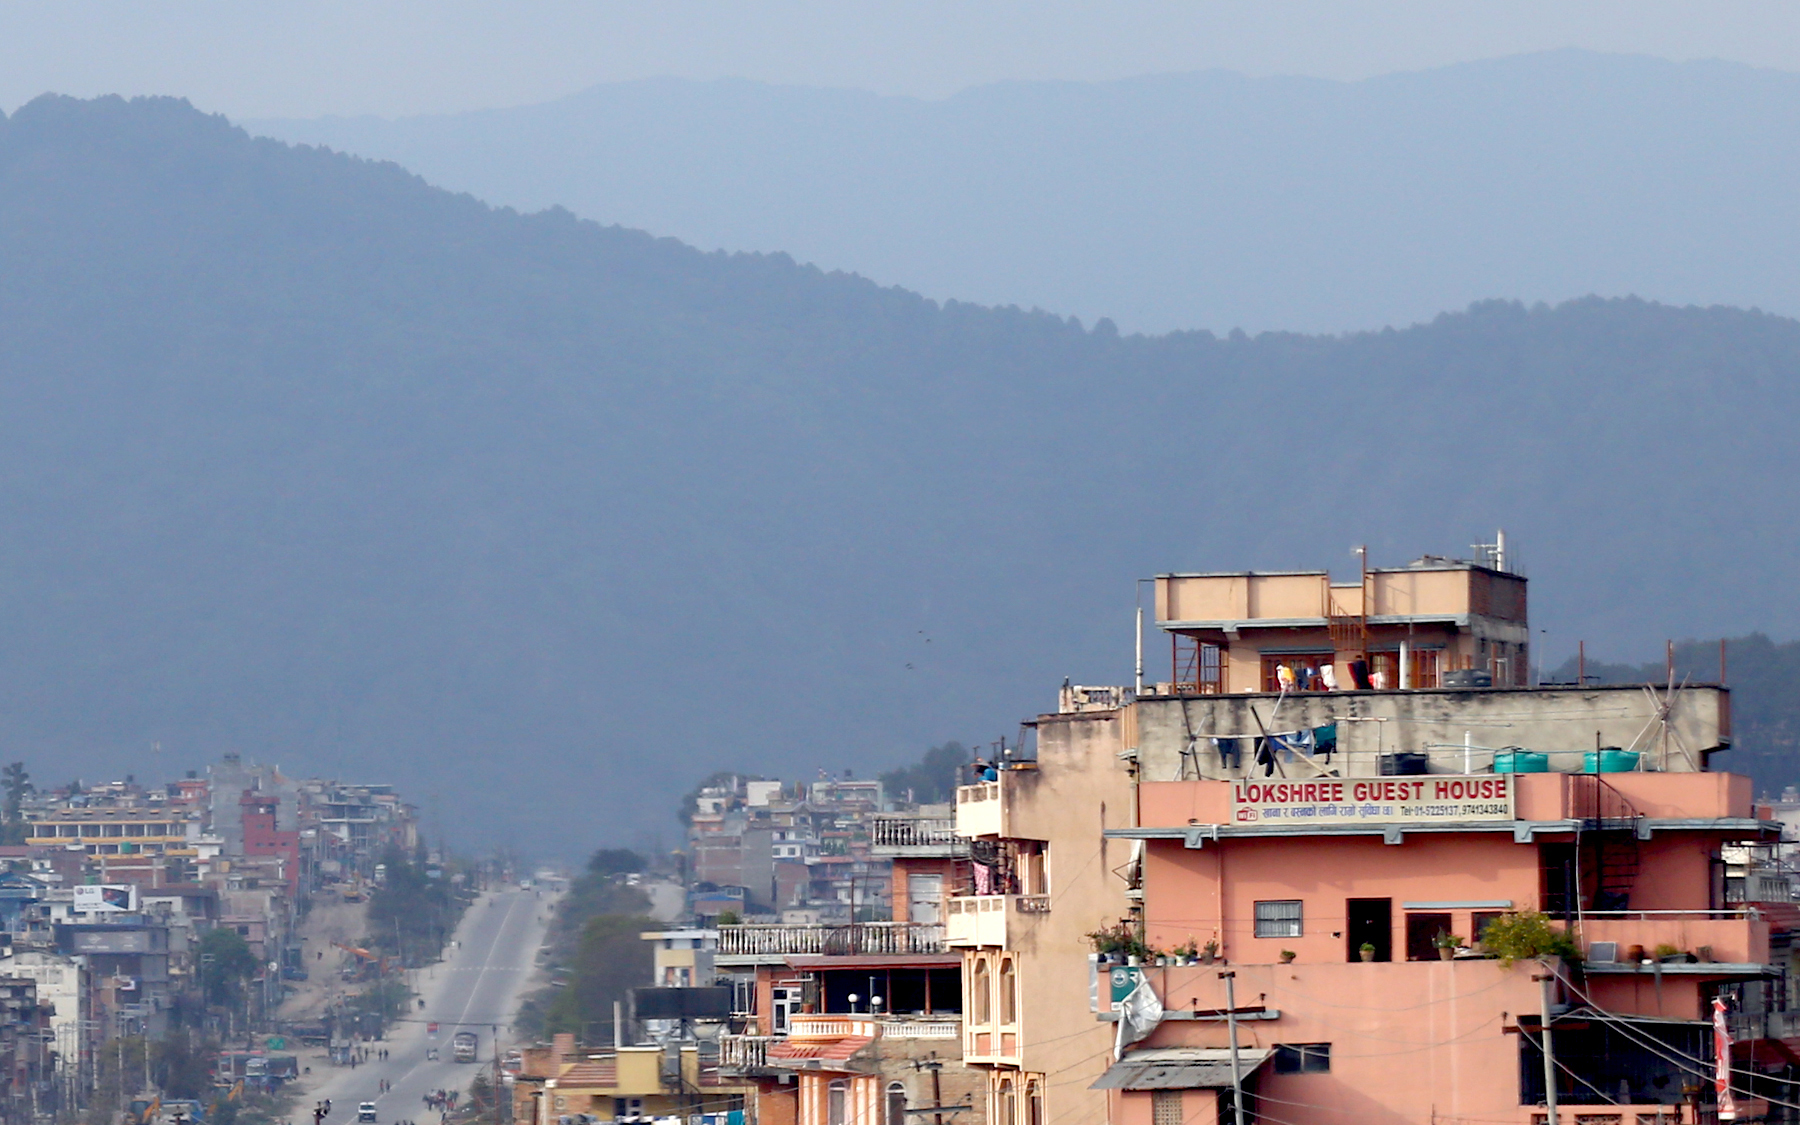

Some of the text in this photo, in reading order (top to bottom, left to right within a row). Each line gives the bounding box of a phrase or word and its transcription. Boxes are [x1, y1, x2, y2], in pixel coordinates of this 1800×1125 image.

[1236, 779, 1507, 803] LOKSHREE GUEST HOUSE
